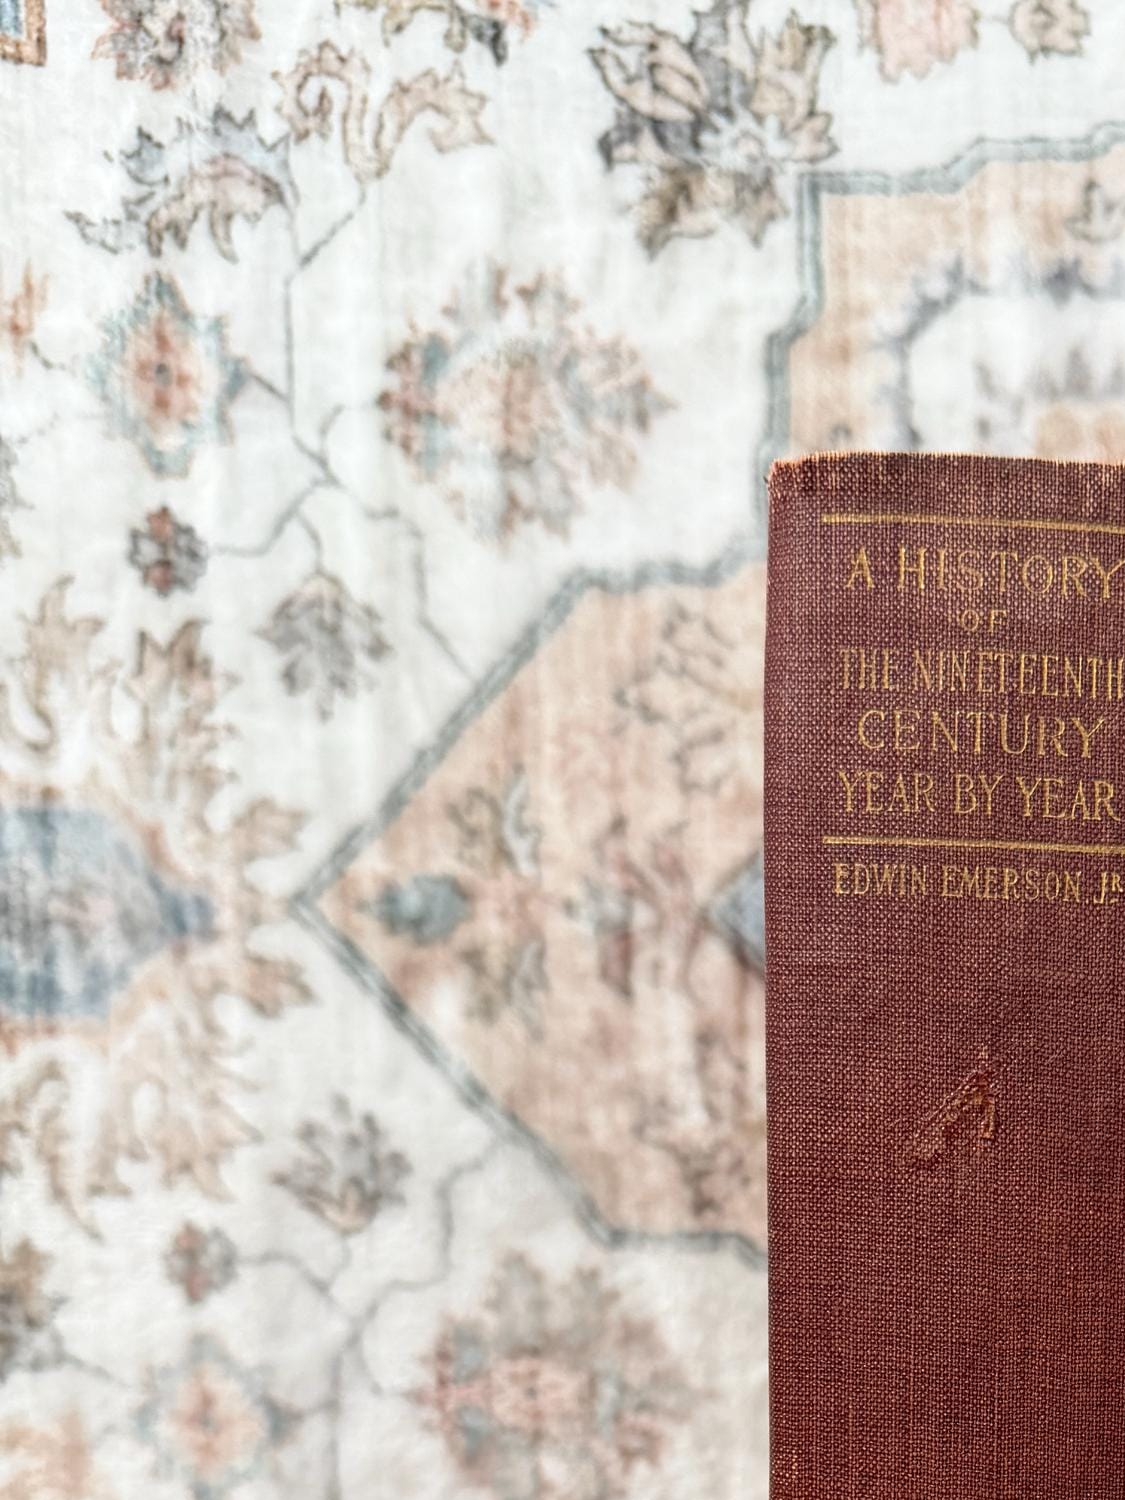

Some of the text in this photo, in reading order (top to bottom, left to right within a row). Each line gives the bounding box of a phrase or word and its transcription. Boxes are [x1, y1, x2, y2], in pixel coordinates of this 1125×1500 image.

[845, 548, 875, 590] A
[958, 609, 1008, 634] OF
[838, 648, 1124, 700] THE NINETEENTH
[856, 709, 1107, 759] CENTURY
[838, 770, 1121, 822] YEAR BY YEAR
[831, 862, 928, 896] EDWIN
